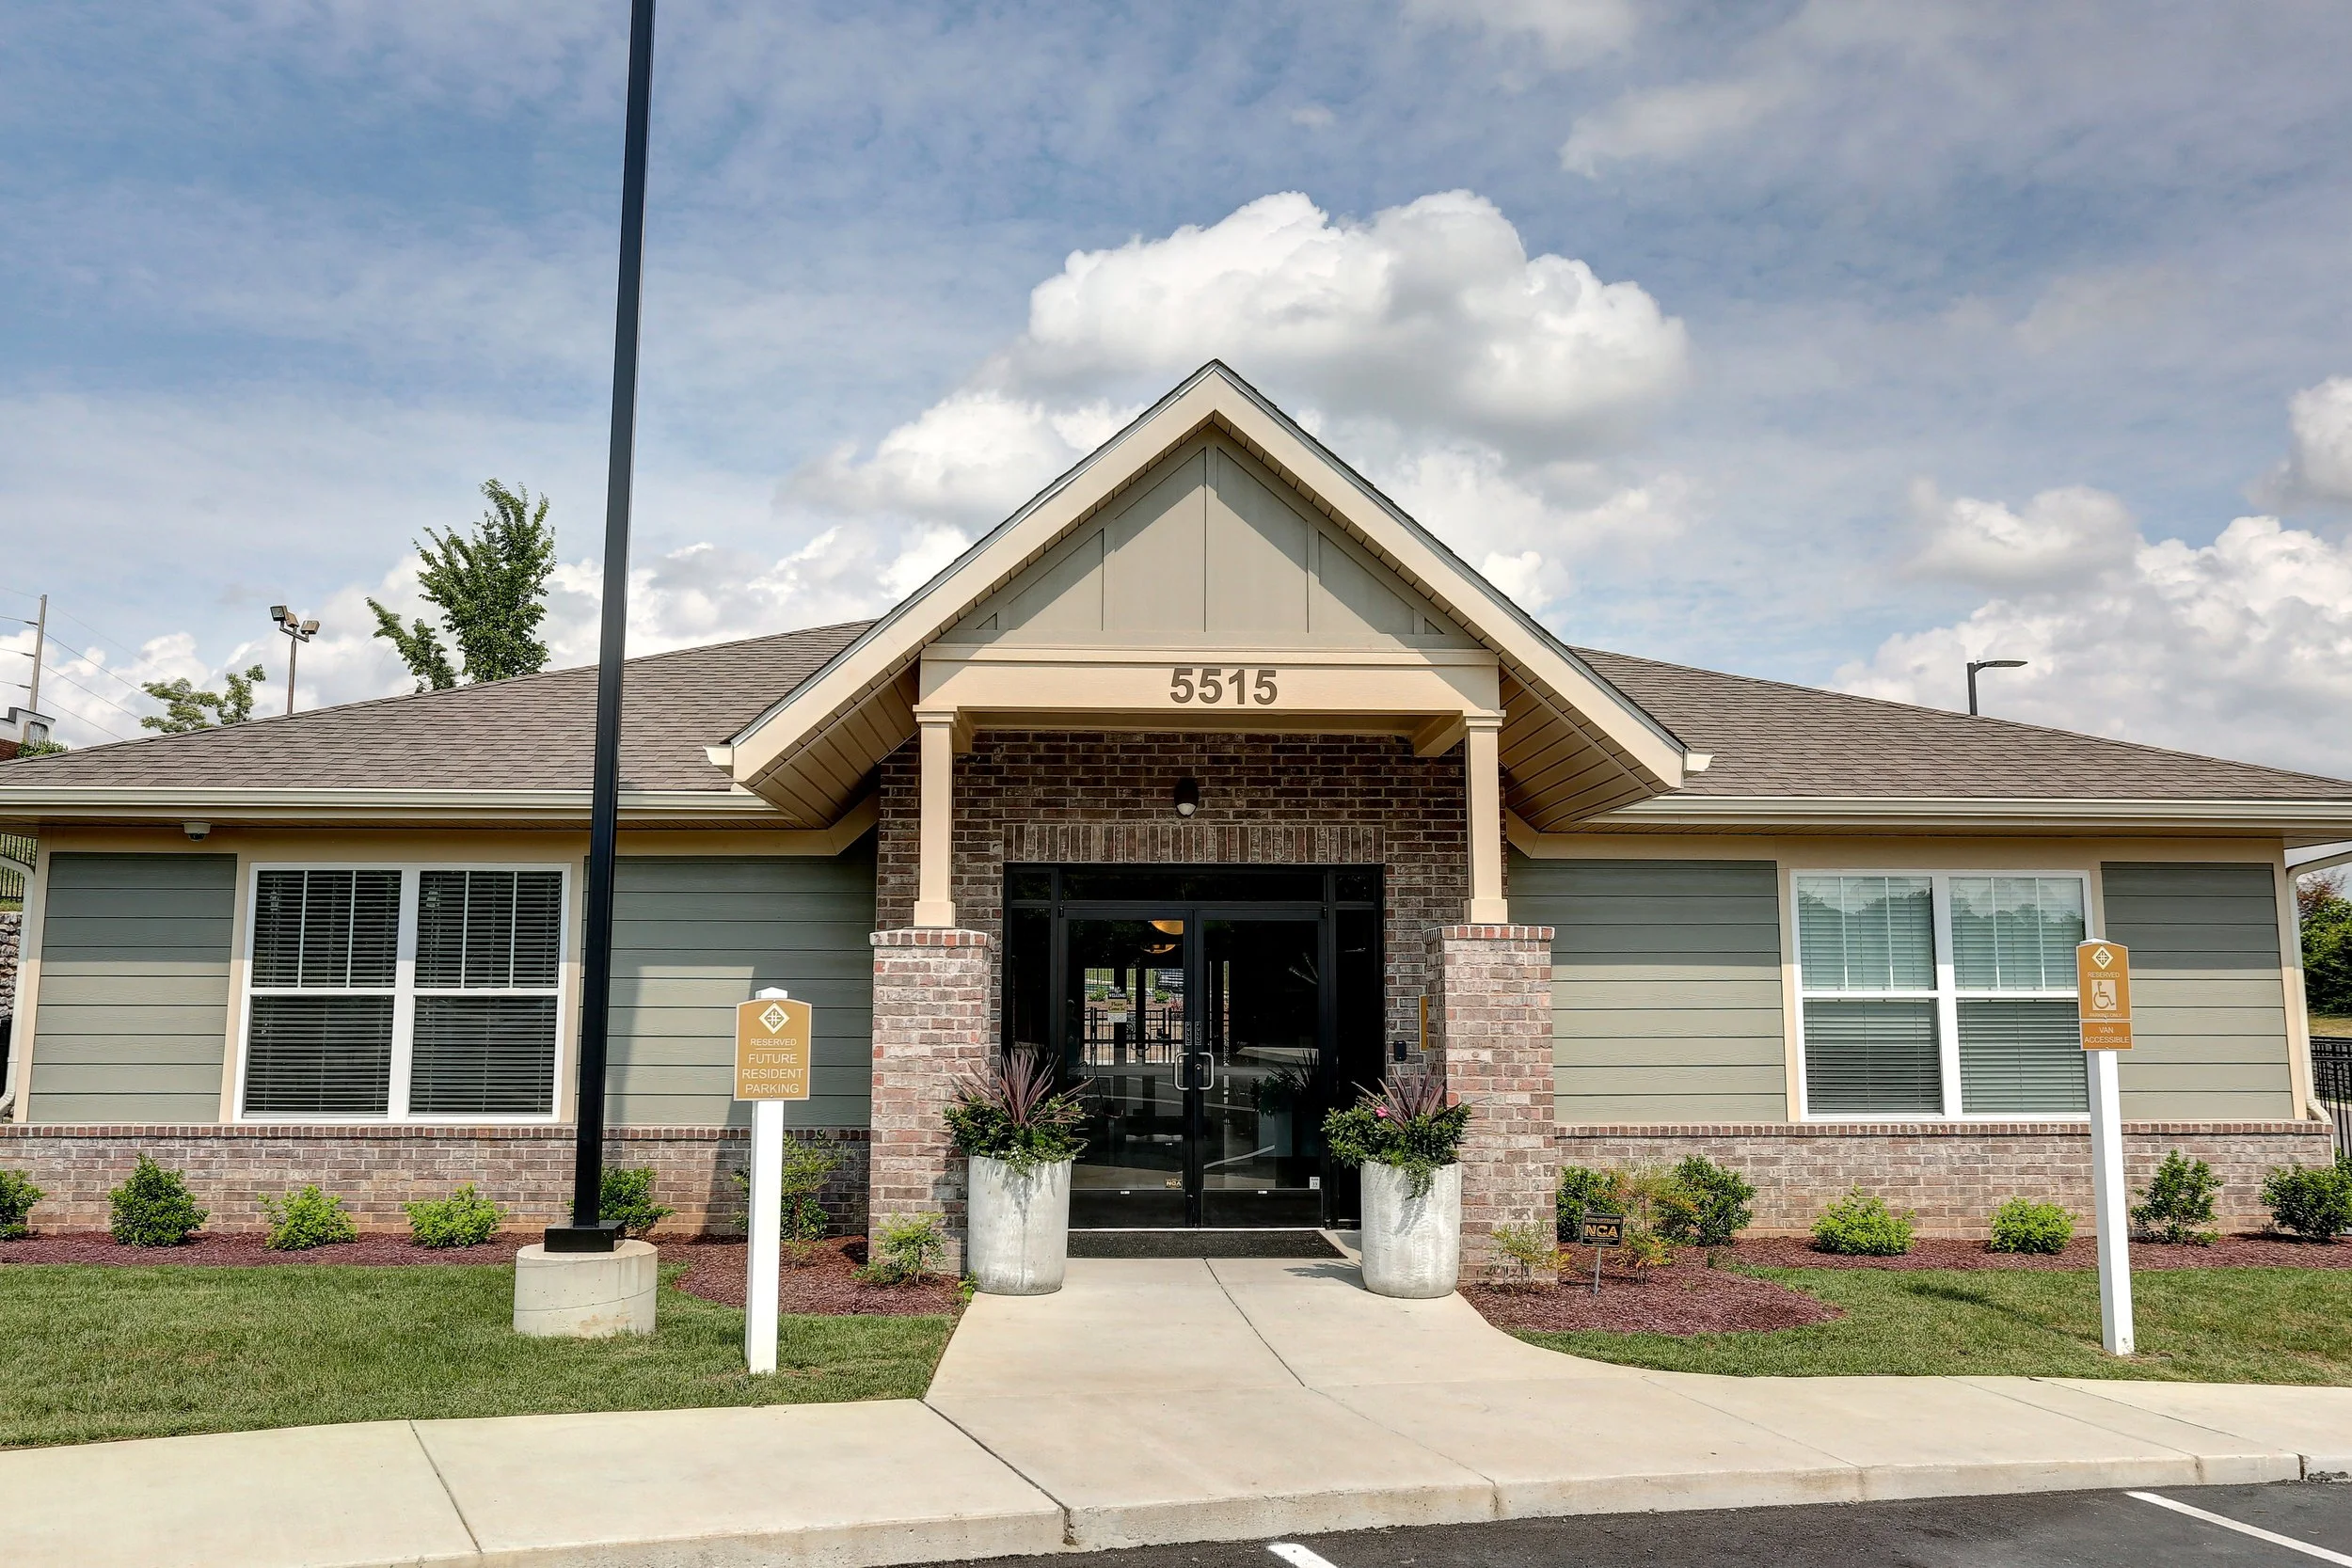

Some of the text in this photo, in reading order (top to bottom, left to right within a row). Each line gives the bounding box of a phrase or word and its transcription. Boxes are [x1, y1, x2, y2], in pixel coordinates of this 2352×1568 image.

[1169, 668, 1278, 705] 5515
[750, 1037, 797, 1046] RESERVED
[2084, 1036, 2130, 1044] ACCESSIBLE
[748, 1053, 798, 1064] FUTURE
[741, 1068, 804, 1079] RESIDENT
[745, 1083, 800, 1094] PARKING
[1584, 1224, 1618, 1237] NCA
